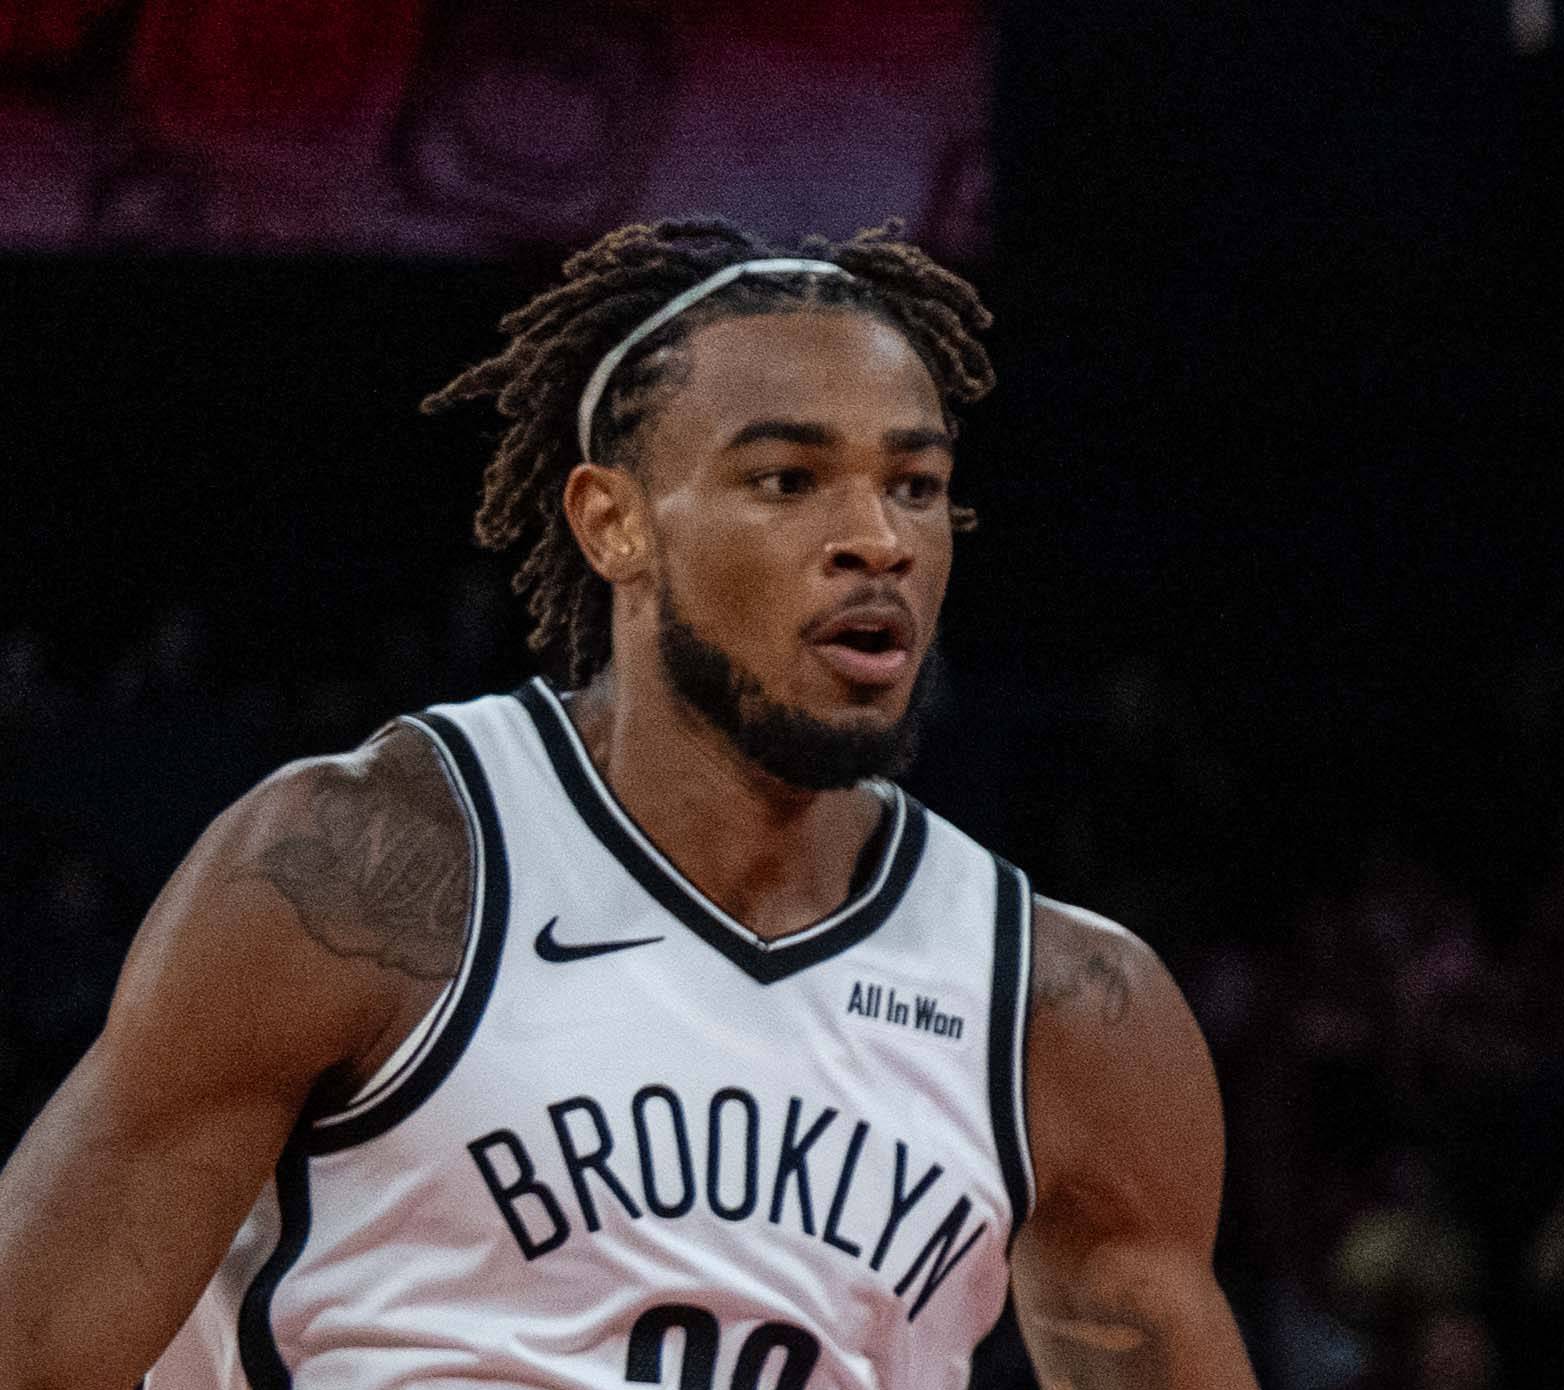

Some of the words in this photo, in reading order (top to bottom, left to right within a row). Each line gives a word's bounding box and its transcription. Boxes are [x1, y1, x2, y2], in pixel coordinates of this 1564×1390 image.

[847, 980, 882, 1018] All
[886, 987, 909, 1026] In
[914, 993, 965, 1040] Won
[466, 1082, 986, 1324] BROOKLYN
